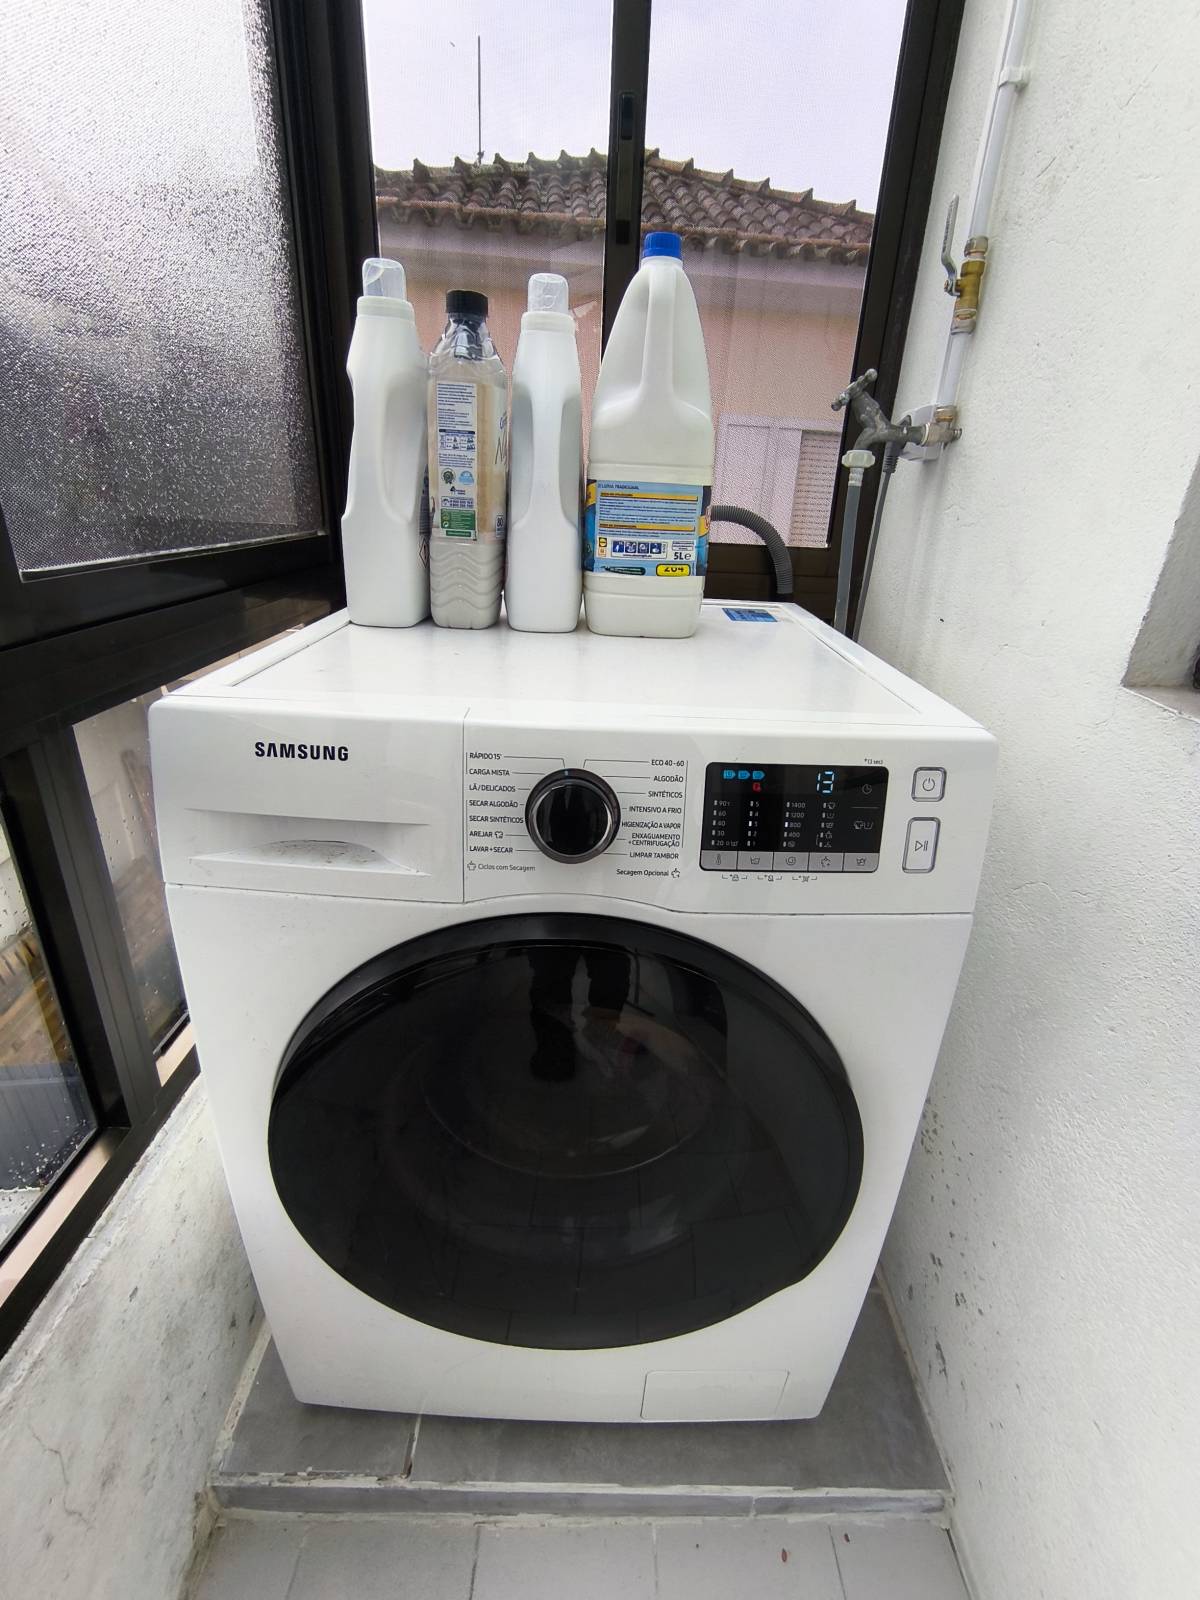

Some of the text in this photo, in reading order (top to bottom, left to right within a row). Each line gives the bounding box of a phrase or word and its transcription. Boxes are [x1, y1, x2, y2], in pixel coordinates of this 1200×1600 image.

[255, 742, 348, 761] SAMSUNG
[654, 774, 684, 783] ALGODÃO
[490, 800, 518, 808] ALGODÃO
[490, 815, 524, 823] SINTÉTICOS
[622, 821, 658, 830] HIGIENIZAÇÃO
